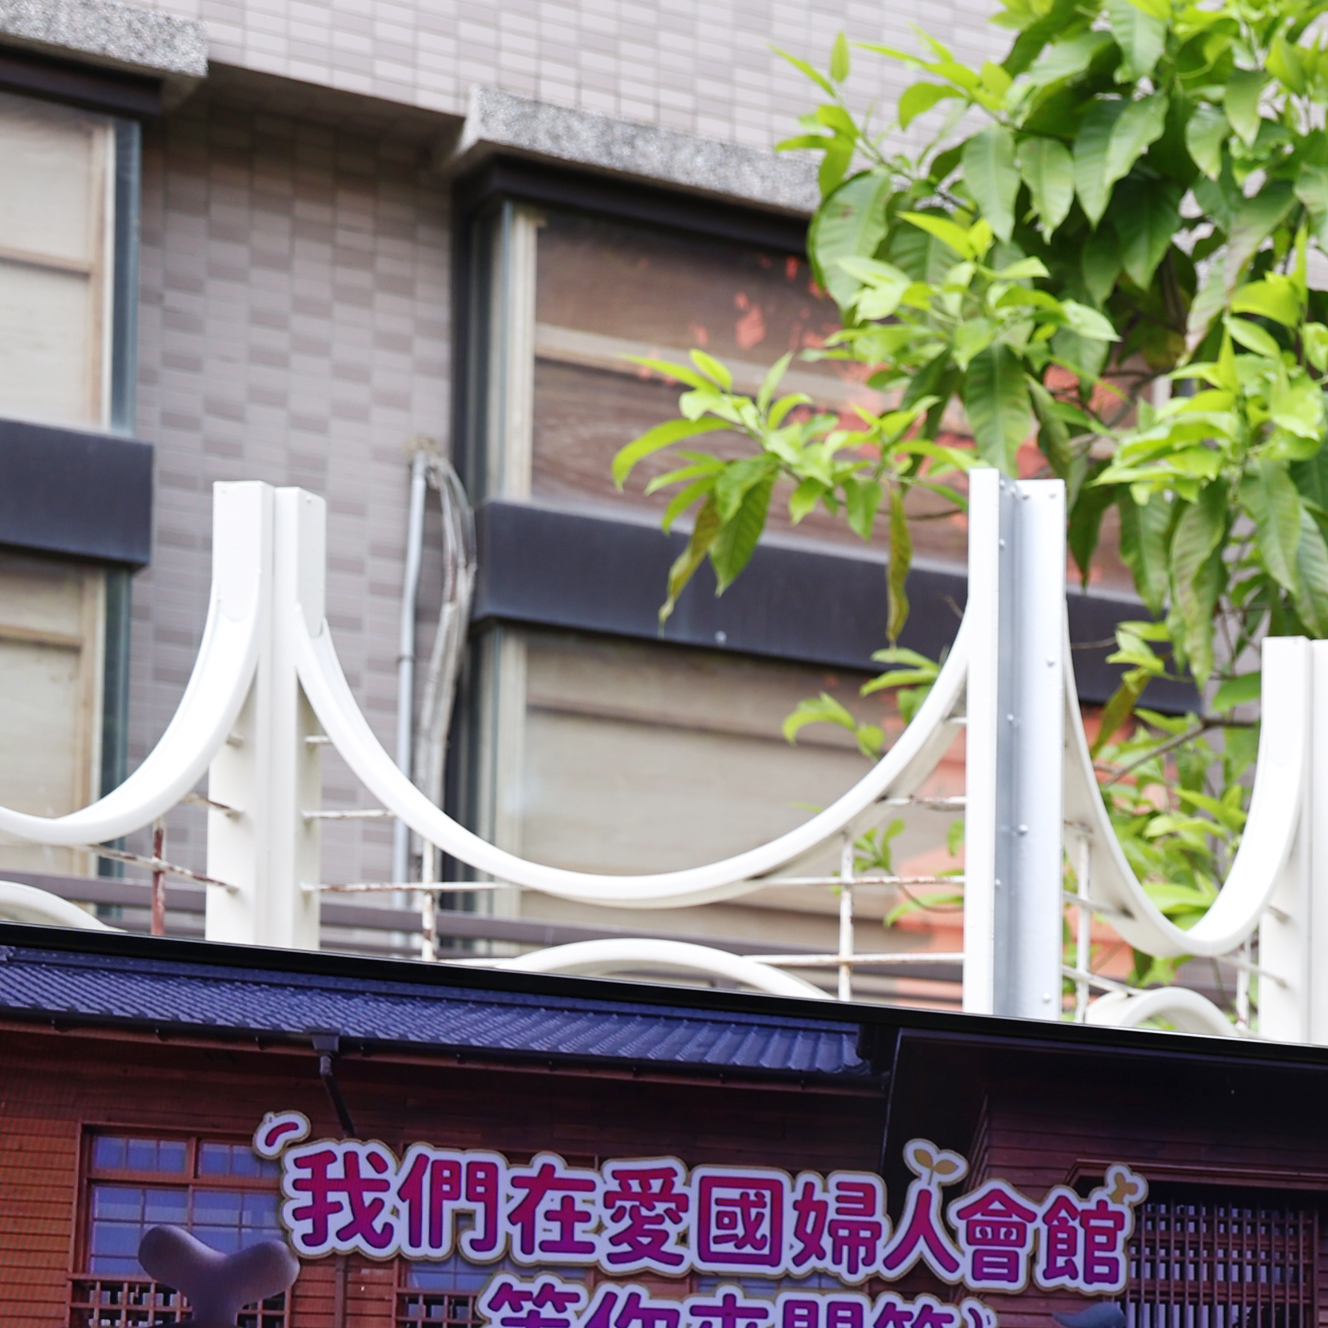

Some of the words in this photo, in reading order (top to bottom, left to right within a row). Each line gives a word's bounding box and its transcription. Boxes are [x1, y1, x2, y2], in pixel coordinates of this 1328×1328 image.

[292, 1147, 1126, 1286] 我們在愛國婦人會館
